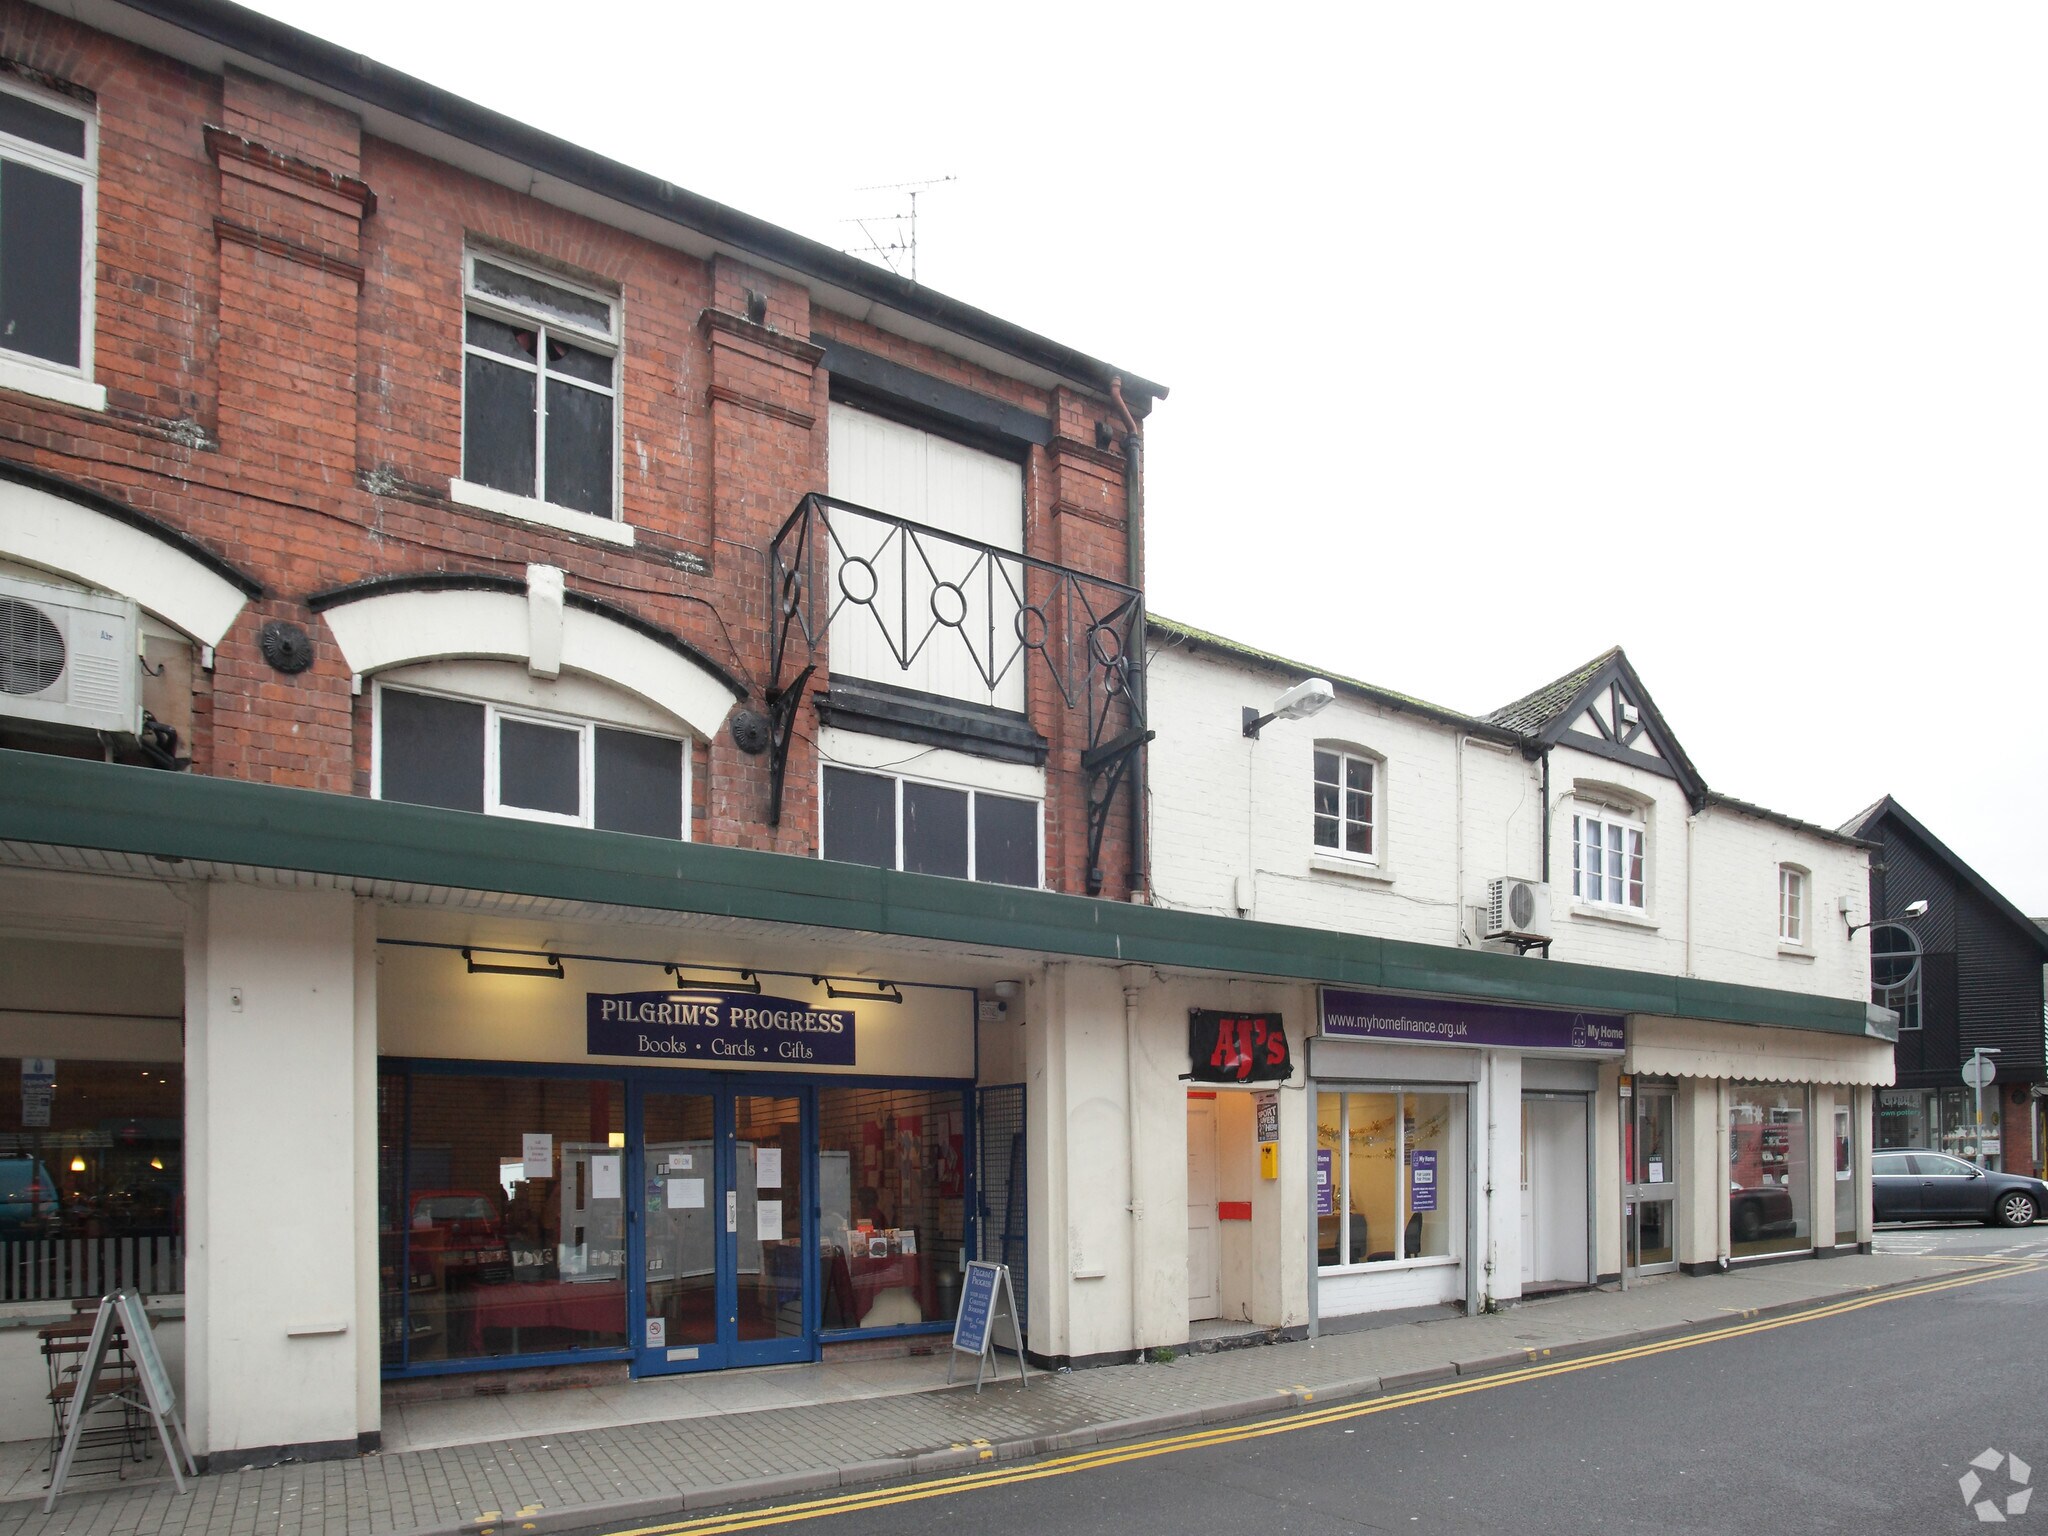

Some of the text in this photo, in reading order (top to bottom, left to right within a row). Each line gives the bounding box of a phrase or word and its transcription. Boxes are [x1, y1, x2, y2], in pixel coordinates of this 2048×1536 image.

[601, 999, 844, 1034] PILGRIM'S PROGRESS
[1327, 1012, 1468, 1039] www.myhomefinance.org.uk
[1587, 1024, 1624, 1041] My Home
[638, 1035, 813, 1059] Books Cards Gifts
